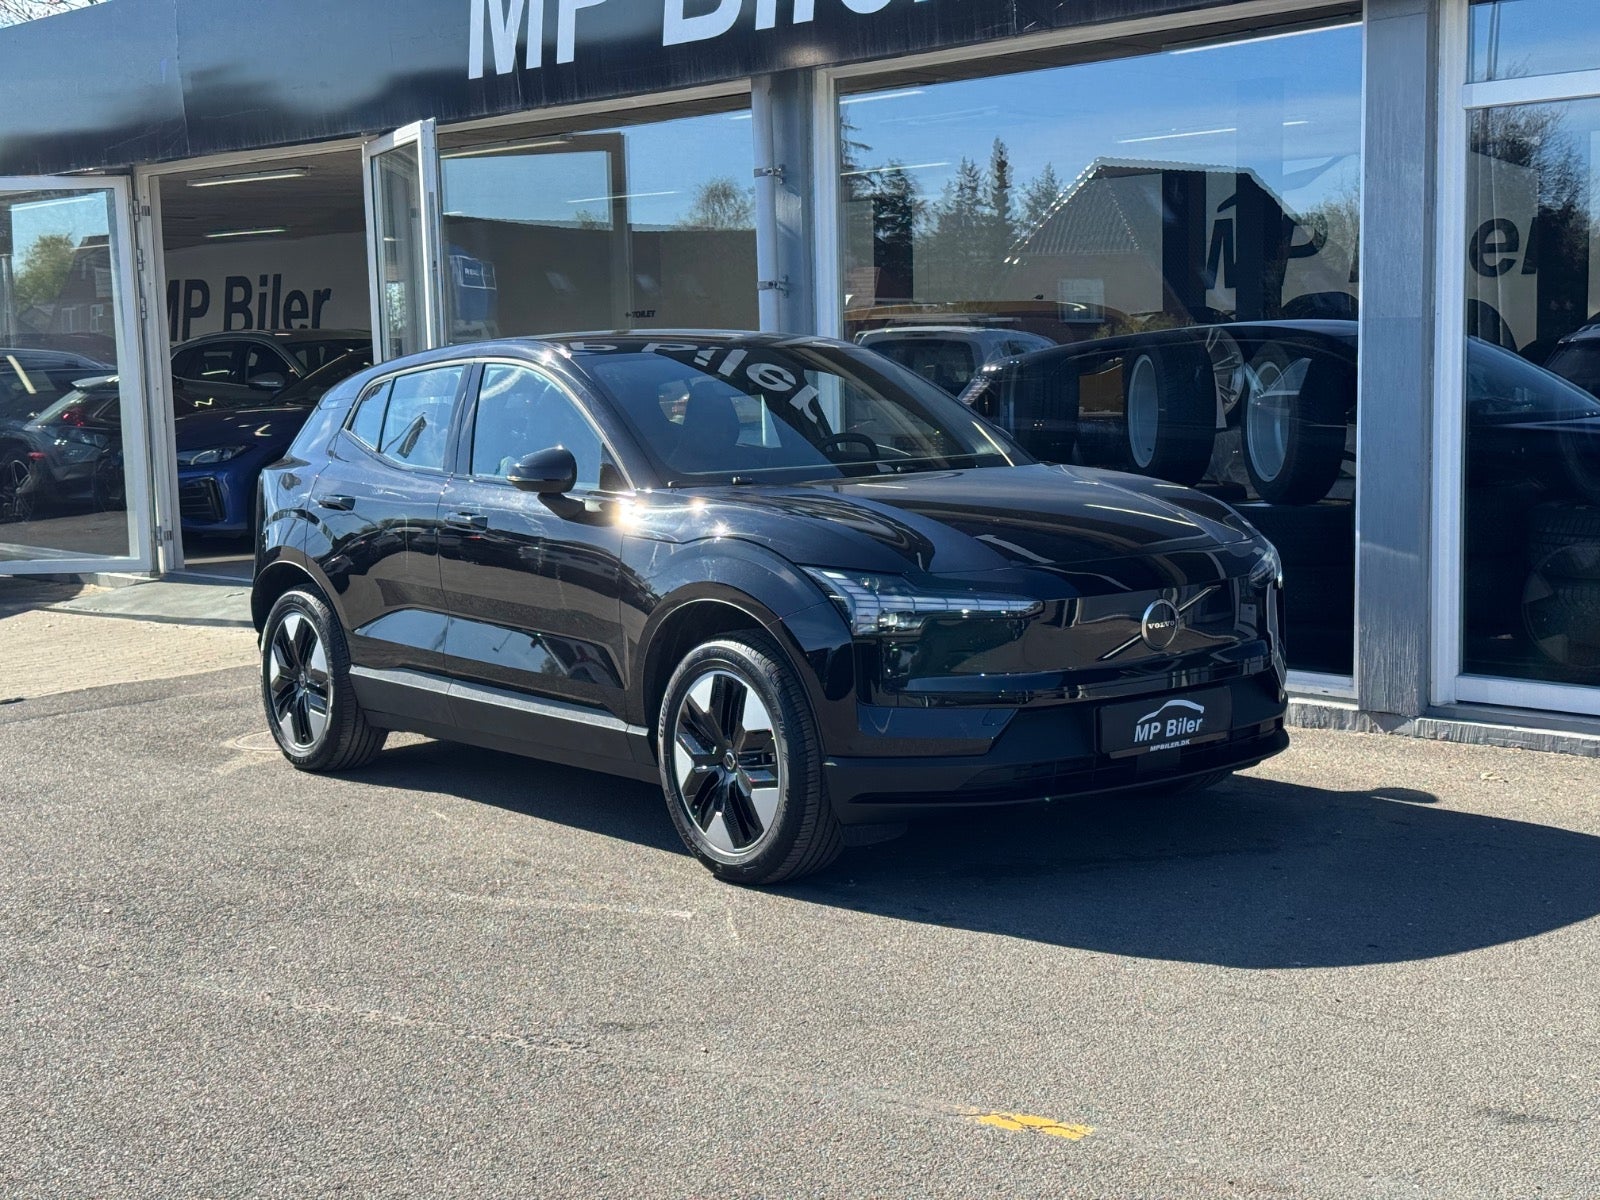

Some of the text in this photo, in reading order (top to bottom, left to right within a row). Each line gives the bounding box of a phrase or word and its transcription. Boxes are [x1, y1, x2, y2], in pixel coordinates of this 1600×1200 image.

[223, 273, 332, 332] Biler
[1147, 620, 1175, 630] VOLVO
[1134, 716, 1204, 743] MP Biler
[1149, 738, 1191, 752] MPBILER.DK
